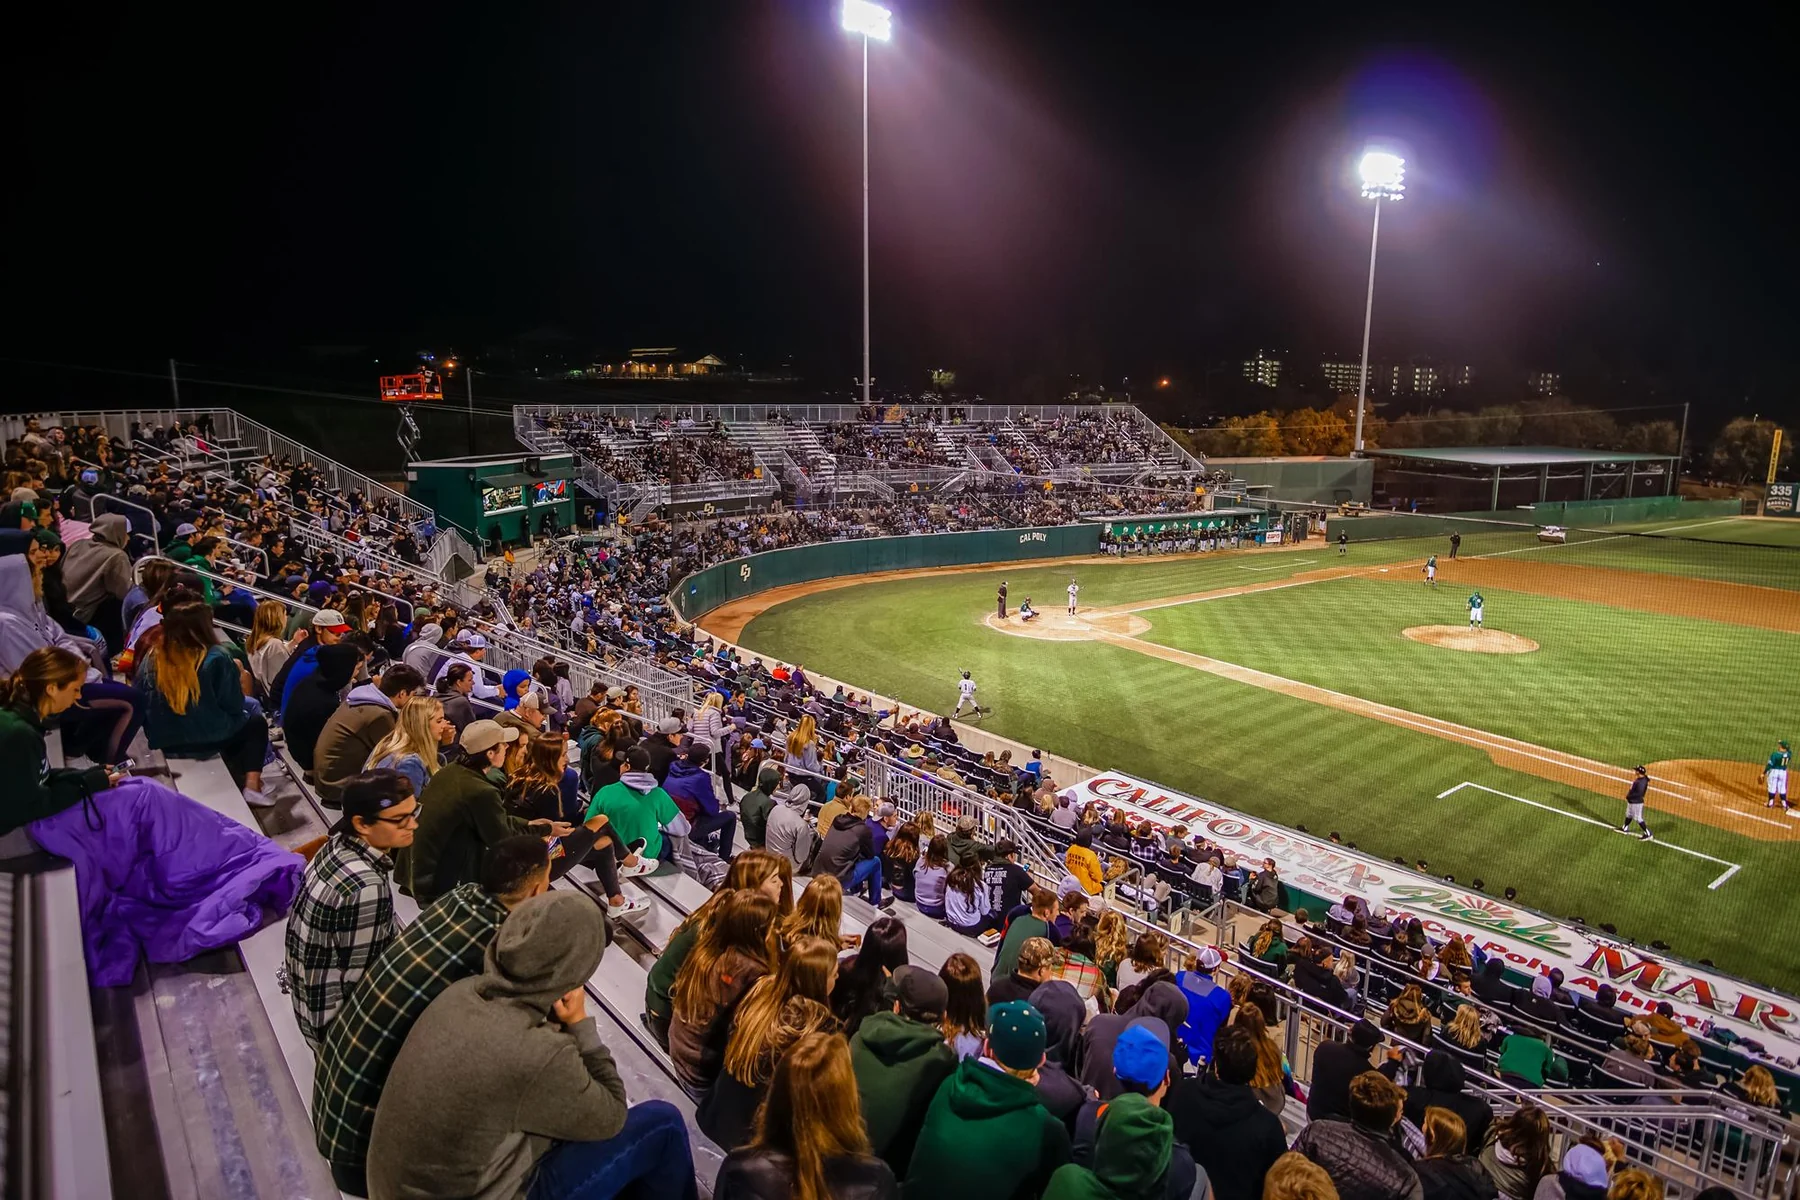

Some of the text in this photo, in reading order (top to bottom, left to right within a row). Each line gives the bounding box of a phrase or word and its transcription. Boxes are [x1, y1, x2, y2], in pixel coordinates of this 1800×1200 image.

[1770, 485, 1793, 496] 335
[1019, 532, 1047, 543] CAL POLY
